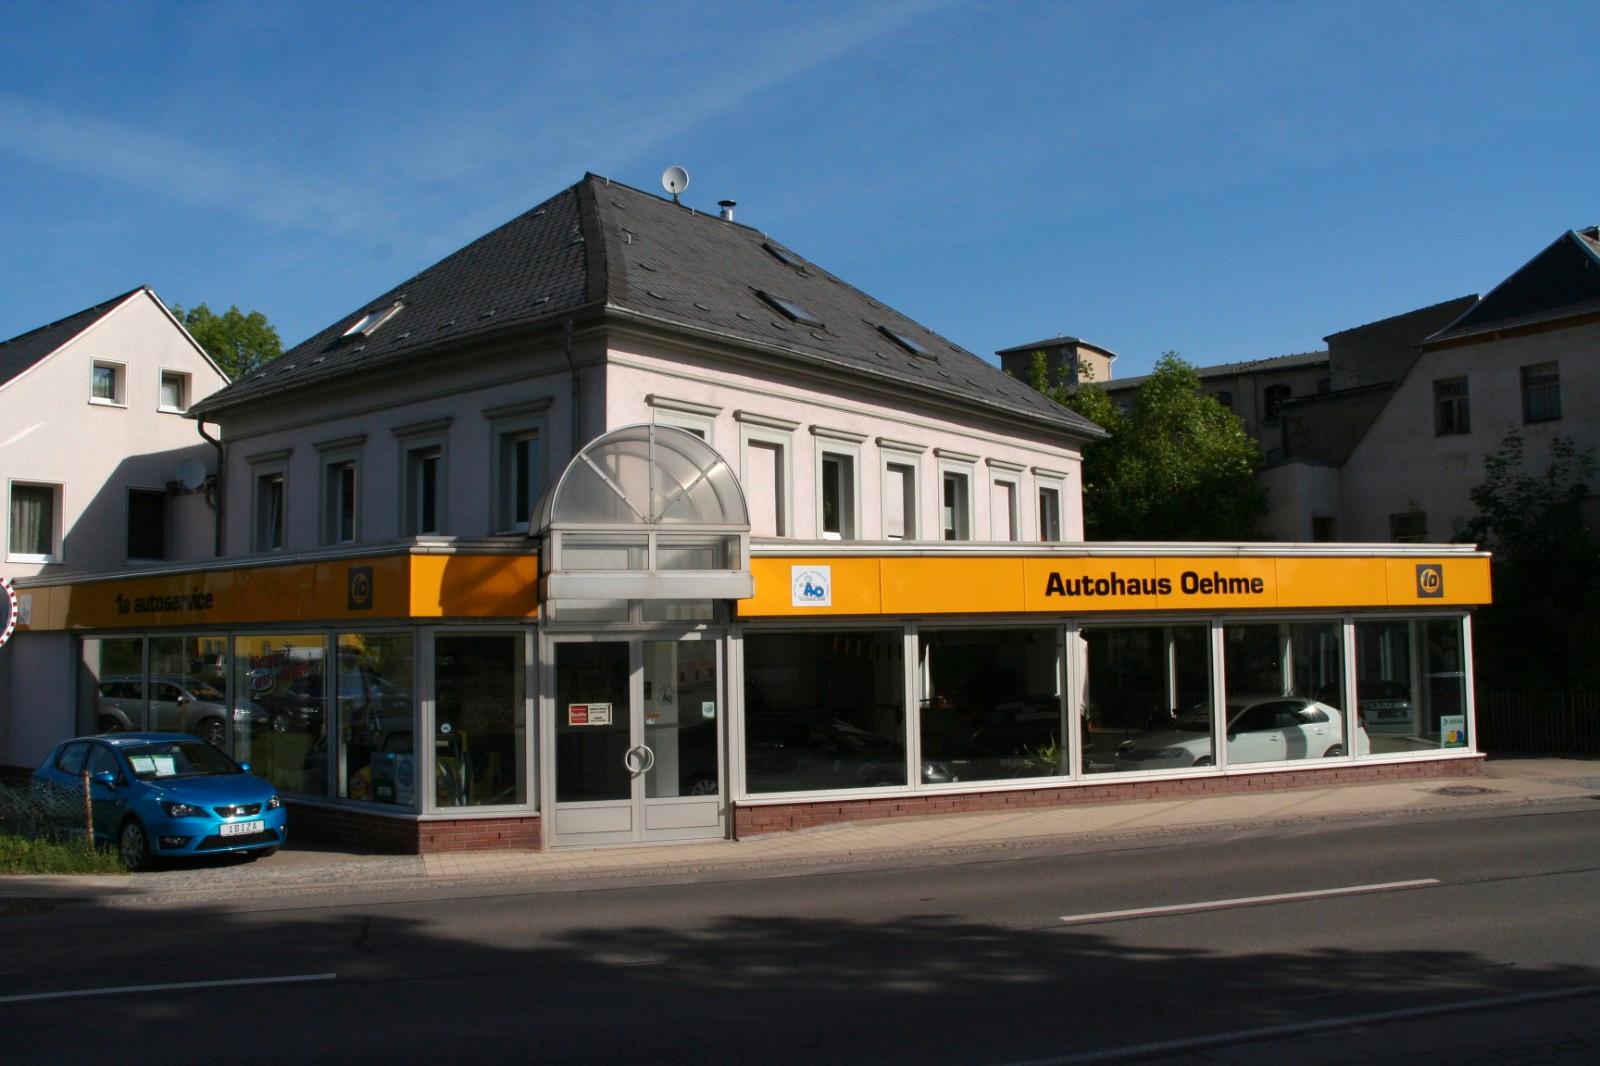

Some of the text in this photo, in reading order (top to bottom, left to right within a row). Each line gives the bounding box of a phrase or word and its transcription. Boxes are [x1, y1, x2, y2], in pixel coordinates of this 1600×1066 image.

[1045, 571, 1264, 596] Autohaus Oehme
[115, 588, 214, 615] 1a autoservice
[230, 822, 258, 833] IBIZA
